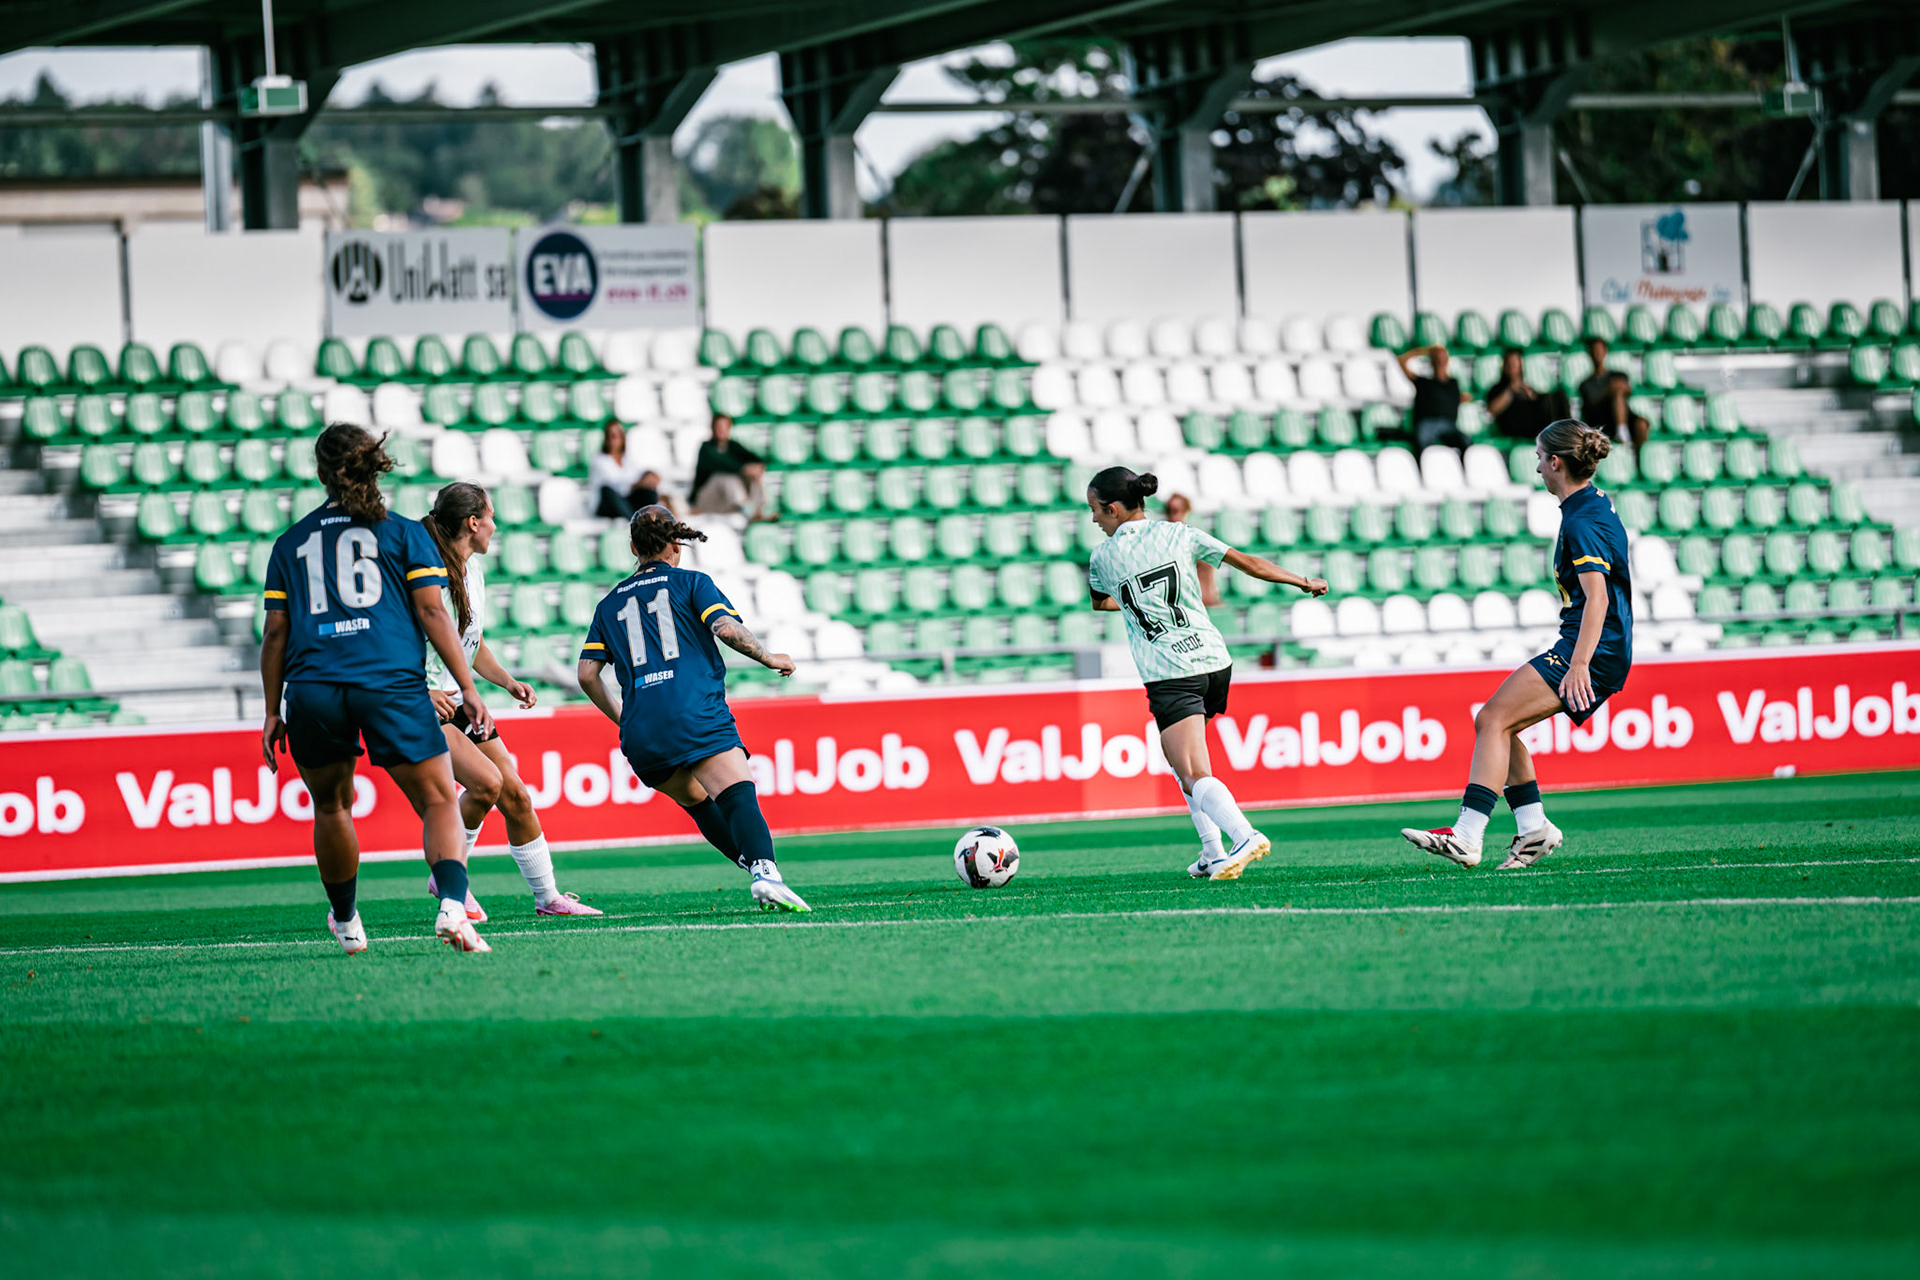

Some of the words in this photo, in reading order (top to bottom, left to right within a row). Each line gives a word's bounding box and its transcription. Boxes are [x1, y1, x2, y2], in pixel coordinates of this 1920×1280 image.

[532, 252, 593, 297] EVA
[296, 526, 383, 615] 16
[1118, 560, 1190, 643] 17
[335, 617, 370, 634] WASER
[617, 588, 680, 668] 11
[1171, 632, 1204, 655] GUEDE
[644, 669, 674, 685] WASER
[747, 733, 930, 797] alJob
[1215, 706, 1447, 771] ValJob
[1470, 693, 1694, 757] alJob
[1717, 681, 1920, 744] ValJob
